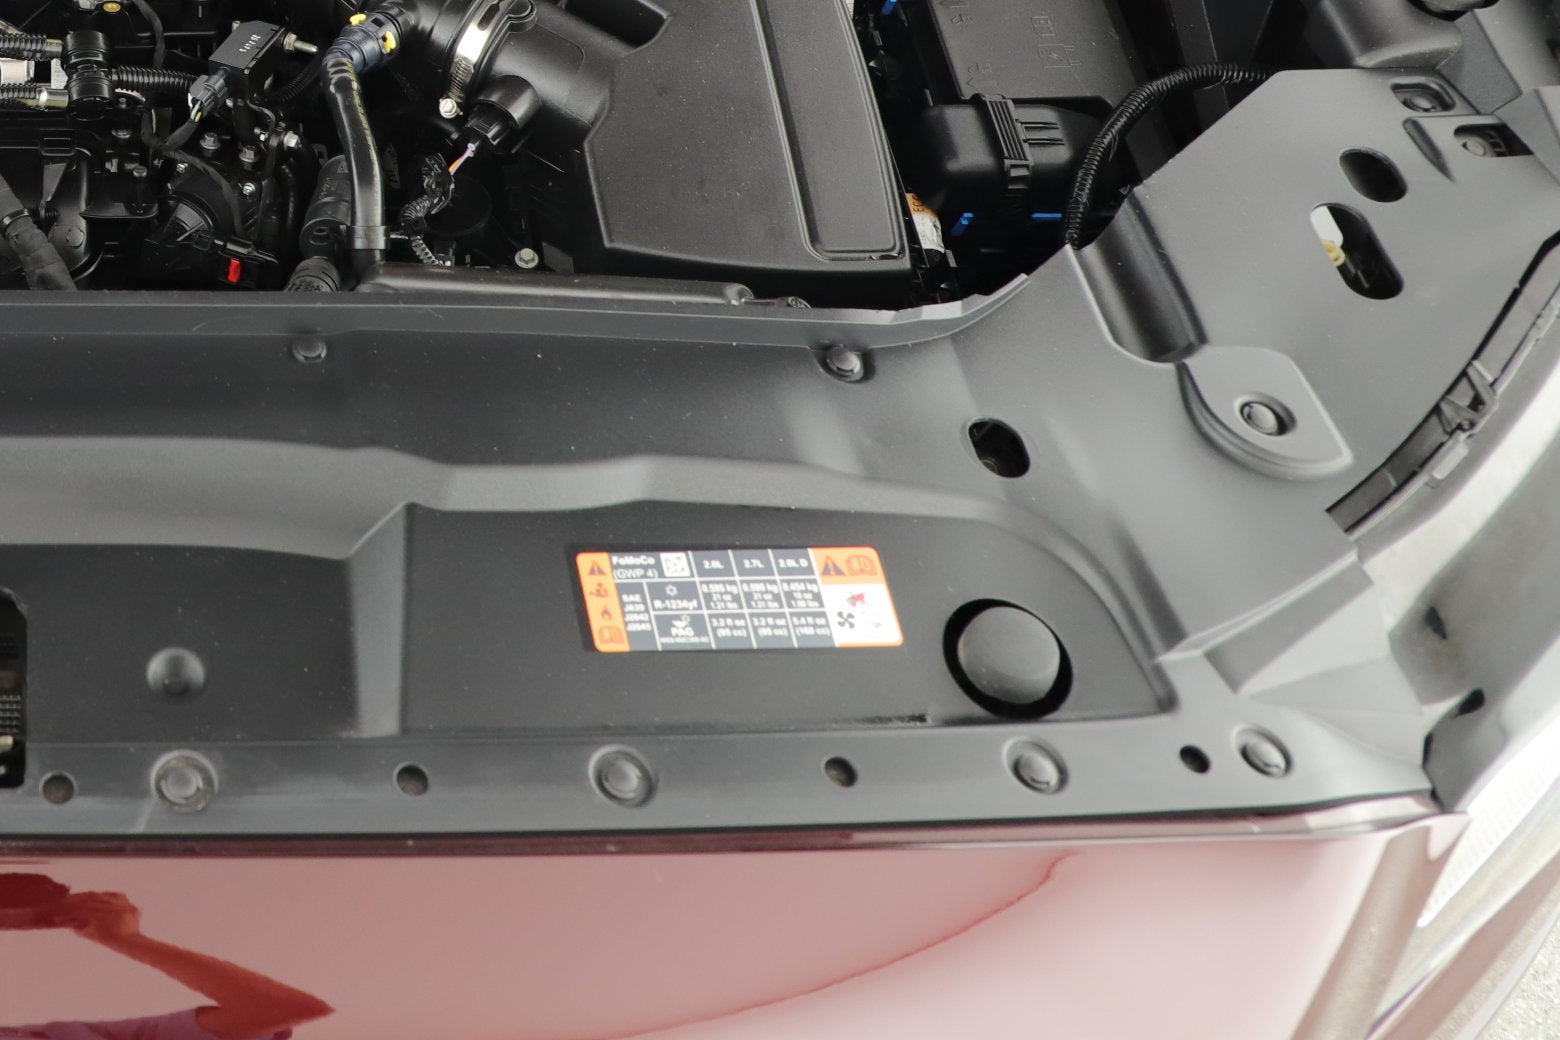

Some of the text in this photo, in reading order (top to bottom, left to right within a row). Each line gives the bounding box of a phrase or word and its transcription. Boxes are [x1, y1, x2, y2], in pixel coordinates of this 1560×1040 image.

[612, 555, 655, 565] FoMoCo
[743, 558, 764, 569] 2.7L
[613, 568, 658, 579] (GWP 4)
[726, 583, 739, 594] kg
[766, 583, 779, 594] kg
[806, 582, 819, 593] kg
[653, 599, 698, 610] R-1234yf
[670, 627, 695, 636] PAG
